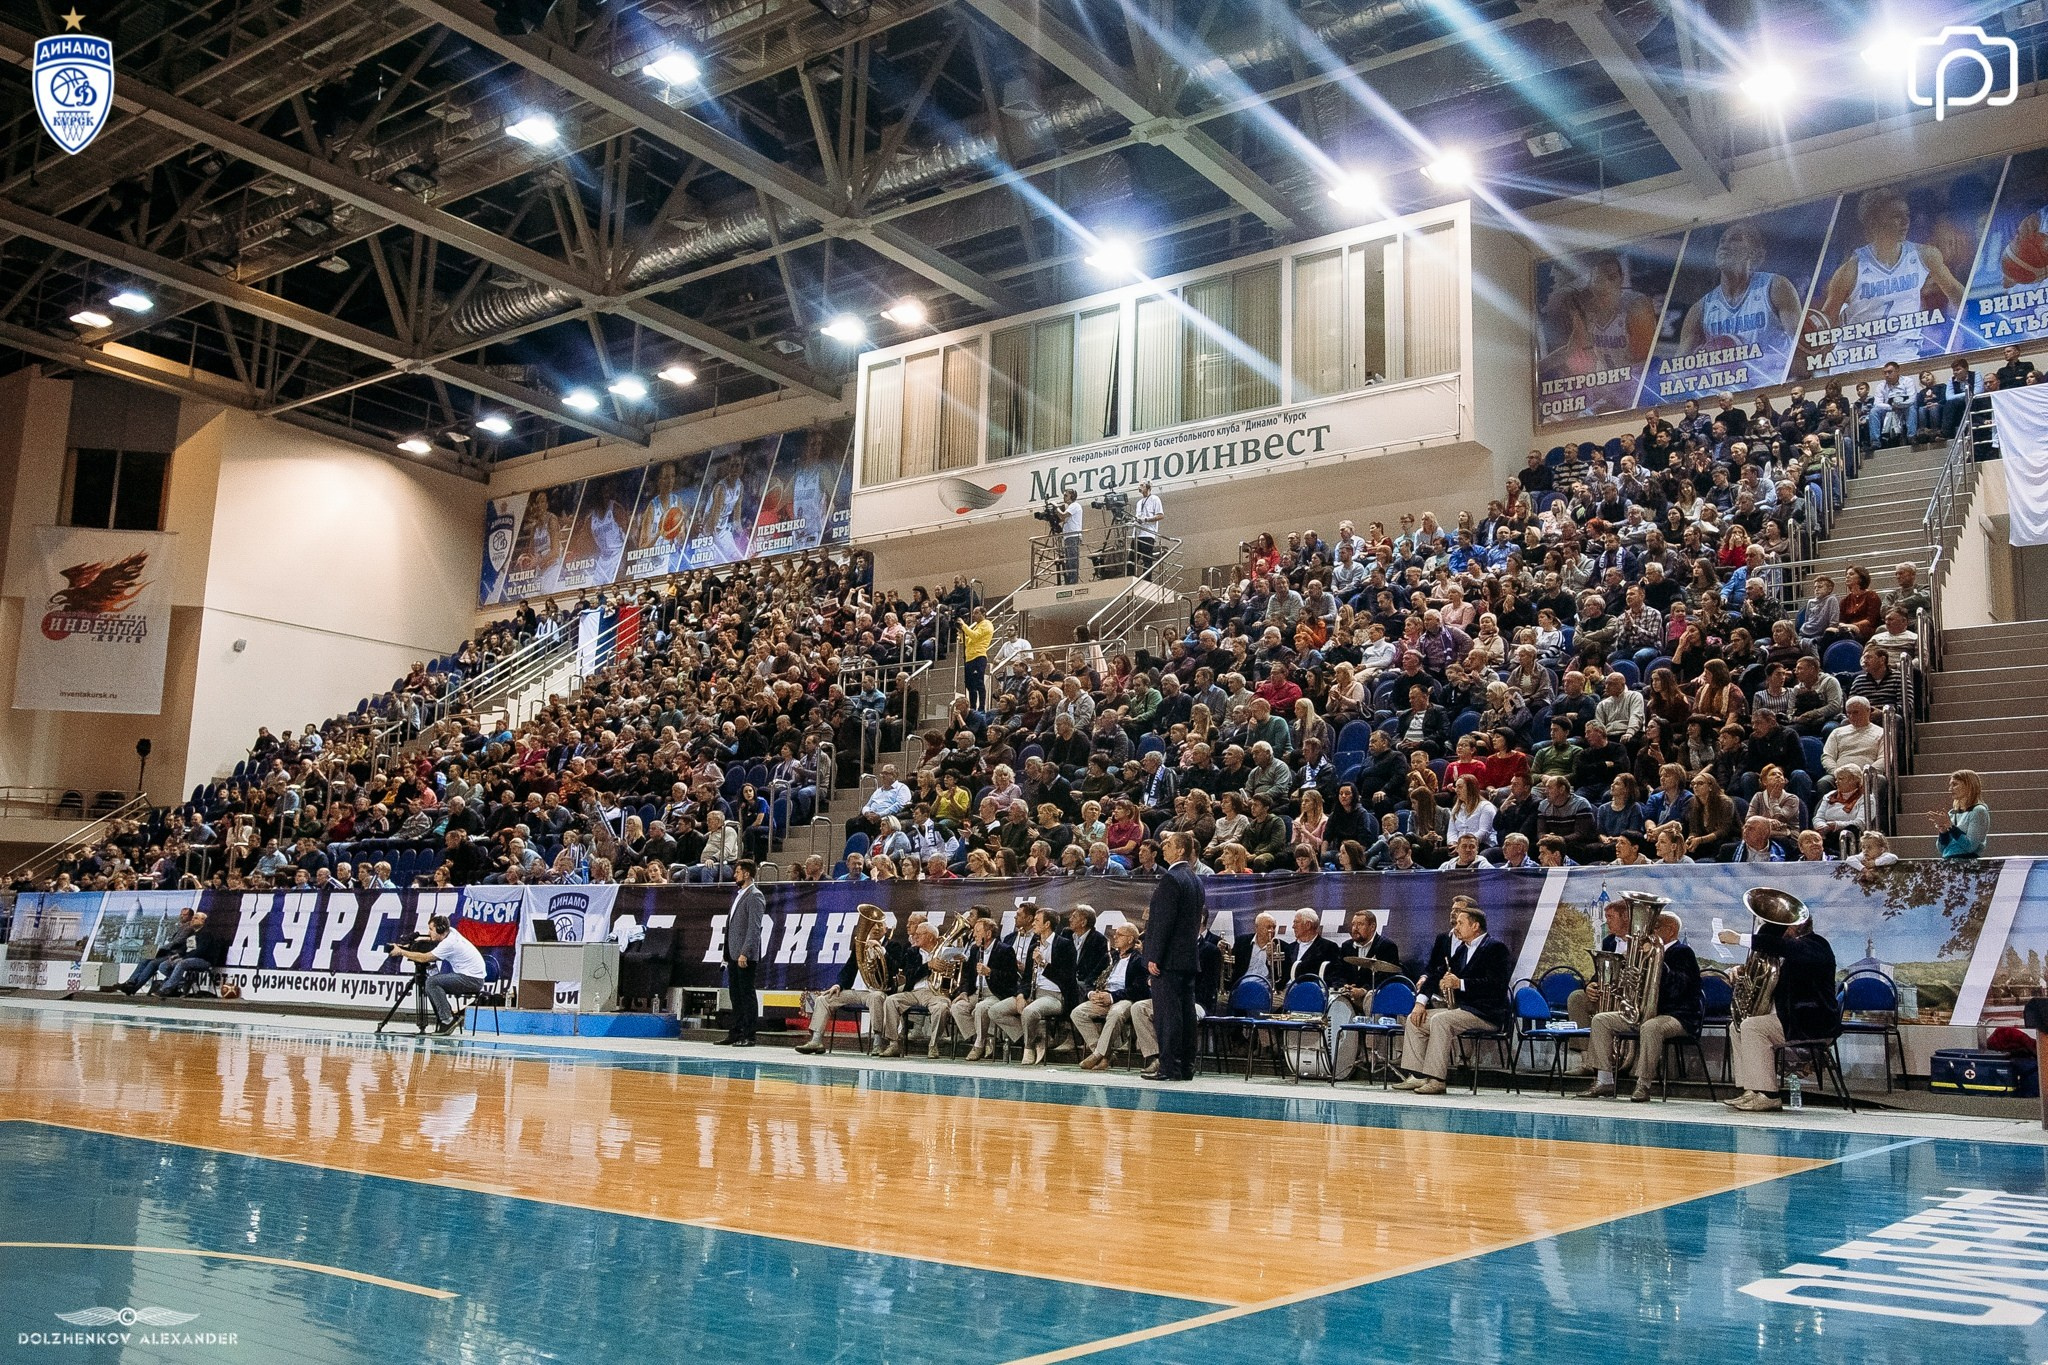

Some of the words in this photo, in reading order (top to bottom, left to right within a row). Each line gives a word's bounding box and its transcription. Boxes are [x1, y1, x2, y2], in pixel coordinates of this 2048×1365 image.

[1859, 273, 1919, 299] ДИНАМО
[1979, 288, 2048, 315] ВИДМ
[1804, 308, 1945, 348] ЧЕРЕМИСИНА
[1659, 343, 1762, 374] АНОЙКИНА
[1807, 344, 1878, 370] МАРИЯ
[1541, 366, 1631, 395] ПЕТРОВИЧ
[1660, 368, 1748, 396] НАТАЛЬЯ
[1542, 396, 1586, 416] СОНЯ
[1069, 445, 1119, 463] генеральный
[1121, 441, 1151, 454] спонсор
[1154, 428, 1214, 448] баскетбольного
[1216, 424, 1240, 437] клуба
[1242, 414, 1282, 431] "Динамо"
[1283, 411, 1307, 425] Курск
[1029, 425, 1331, 502] Металлоинвест
[757, 518, 806, 536] ЛЕВЧЕНКО
[627, 543, 676, 561] КИРИЛЛОВА
[691, 536, 714, 549] КРУЗ
[756, 535, 793, 552] КСЕНИЯ
[565, 558, 595, 572] ЧАРЛЬЗ
[690, 551, 714, 564] АННА
[626, 562, 654, 576] АЛЕНА
[47, 617, 147, 637] ИНВЕНТА
[463, 897, 518, 922] КУРСК
[550, 896, 587, 910] ДИНАМО
[252, 971, 336, 993] физической
